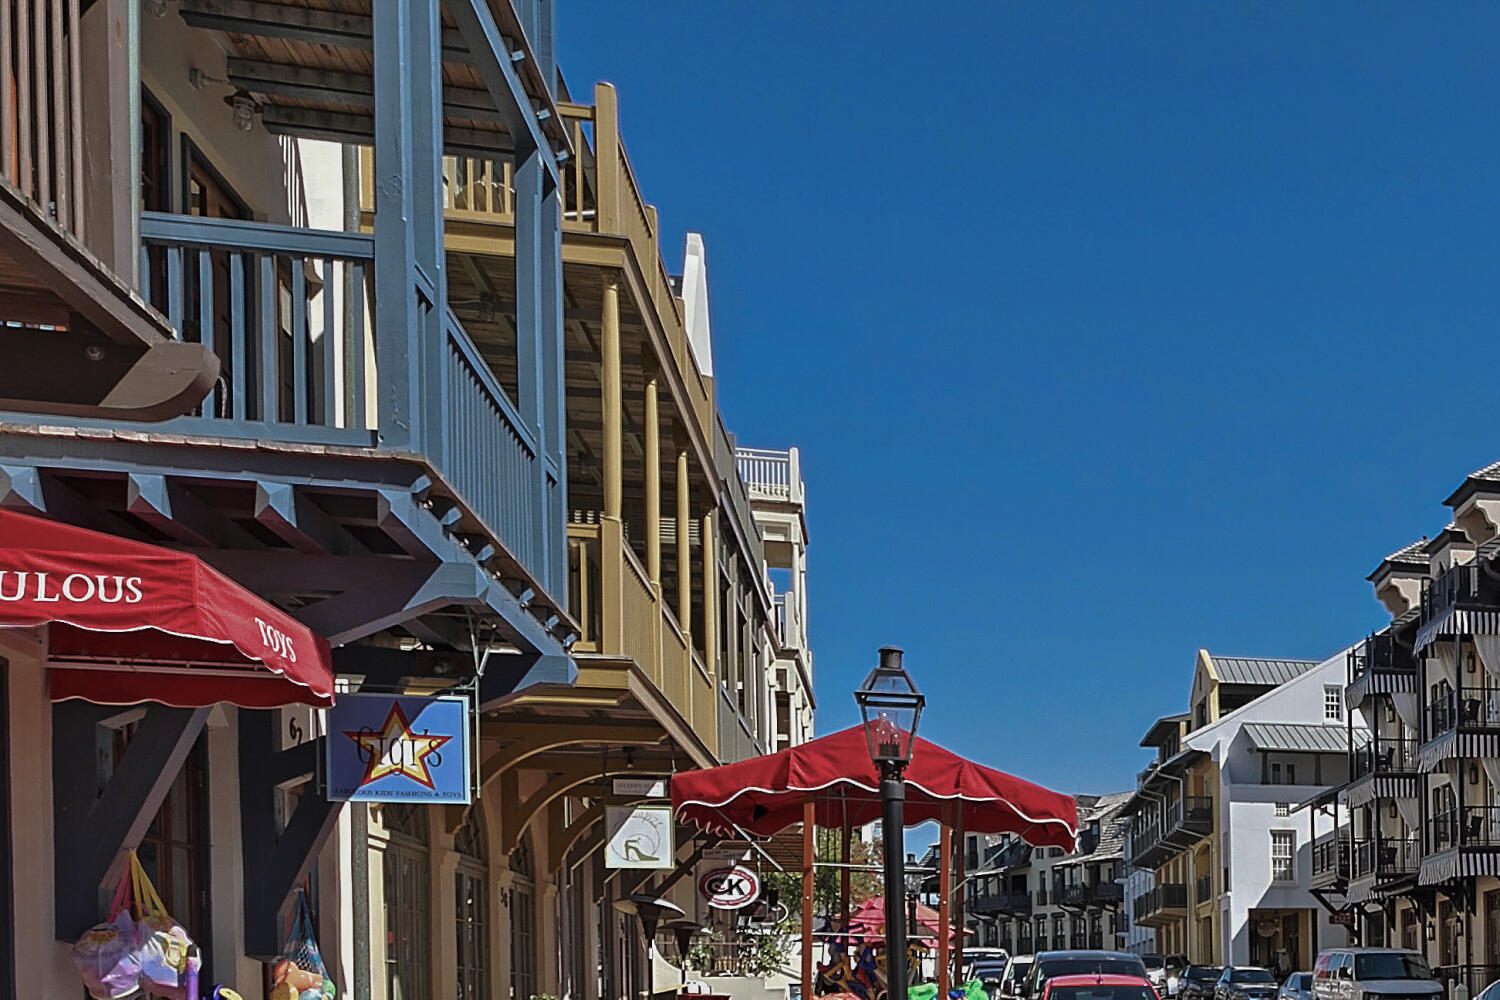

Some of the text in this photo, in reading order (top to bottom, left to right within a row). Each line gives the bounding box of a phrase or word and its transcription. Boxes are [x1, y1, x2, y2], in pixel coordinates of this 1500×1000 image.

[254, 616, 297, 663] TOYS
[395, 789, 433, 798] FASHIONS
[442, 791, 462, 799] TOYS
